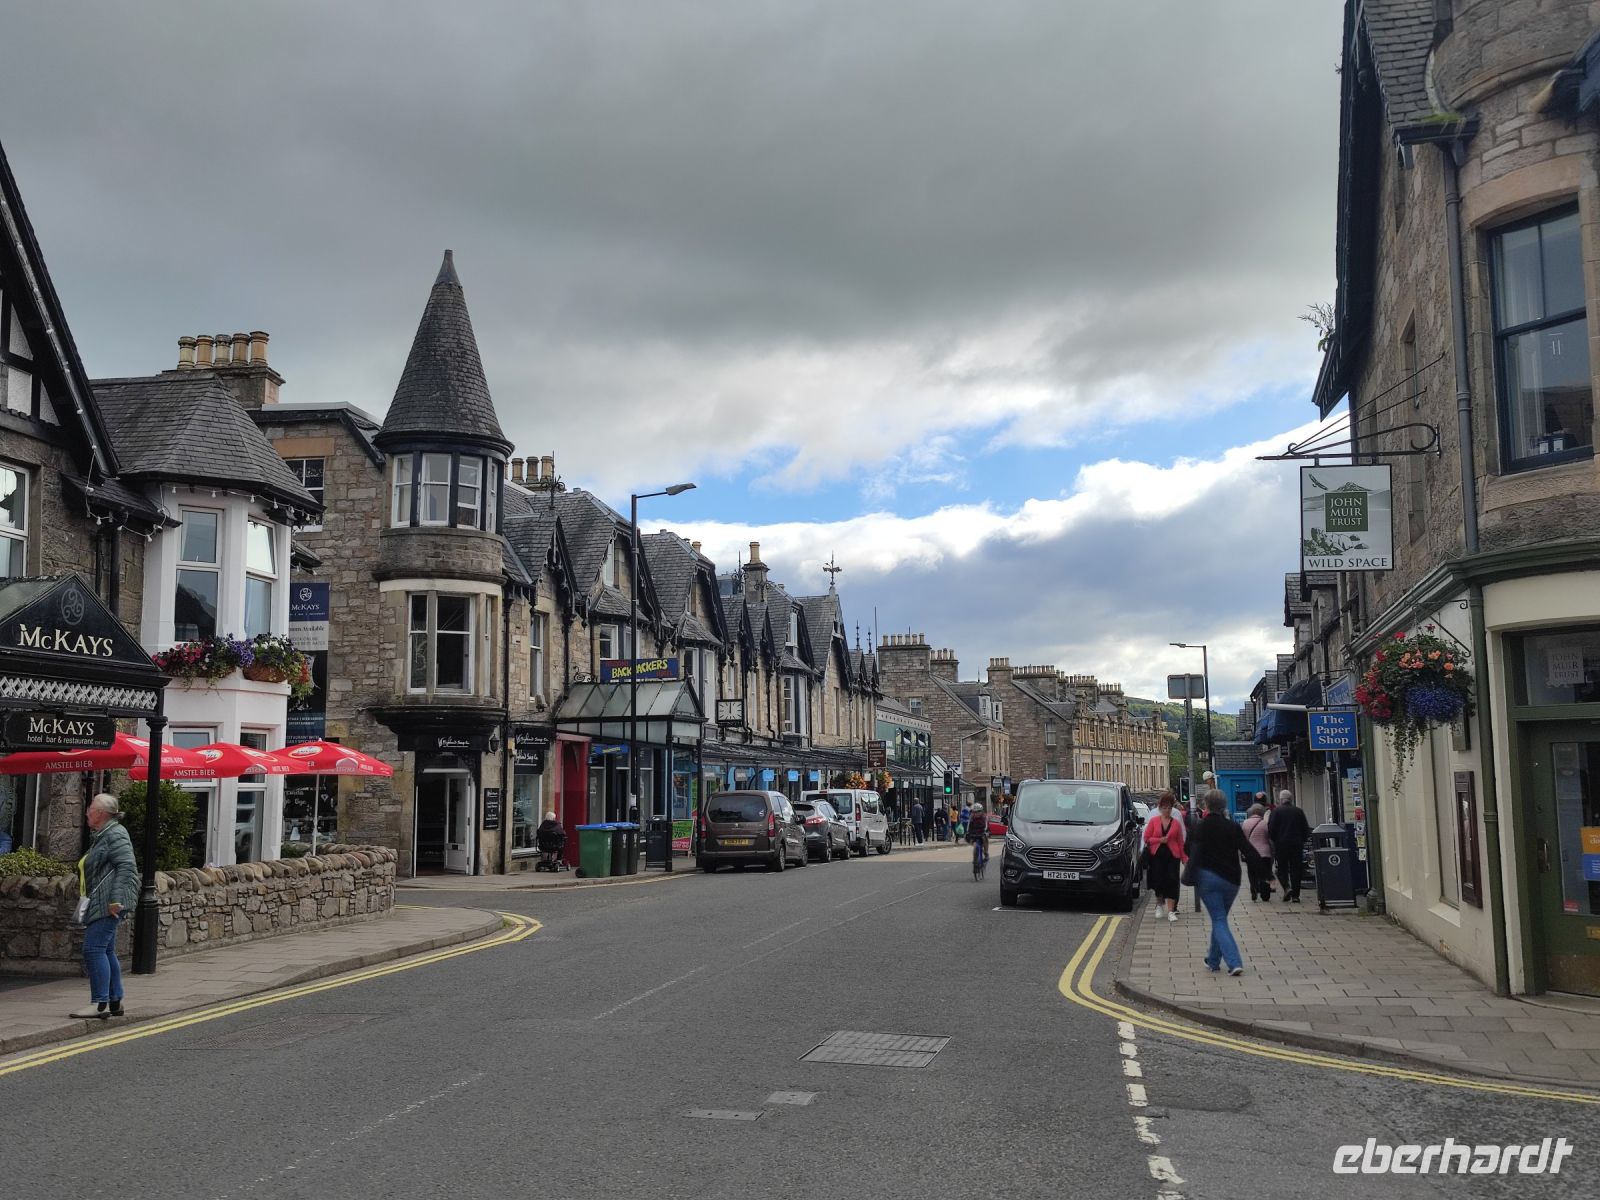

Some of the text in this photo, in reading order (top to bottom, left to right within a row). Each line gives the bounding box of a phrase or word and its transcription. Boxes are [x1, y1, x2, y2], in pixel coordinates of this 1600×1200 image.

[1330, 497, 1362, 508] JOHN
[1330, 508, 1362, 517] MUIR
[1330, 517, 1362, 526] TRUST
[1308, 557, 1388, 568] WILD SPACE
[611, 659, 668, 679] BACKACKERS
[1320, 715, 1345, 724] The
[1316, 725, 1351, 736] Paper
[27, 734, 43, 742] hotel
[63, 737, 94, 745] restaurant
[1318, 735, 1349, 746] Shop
[45, 760, 93, 769] AMSTEL BIER
[173, 769, 199, 777] AMSTEL
